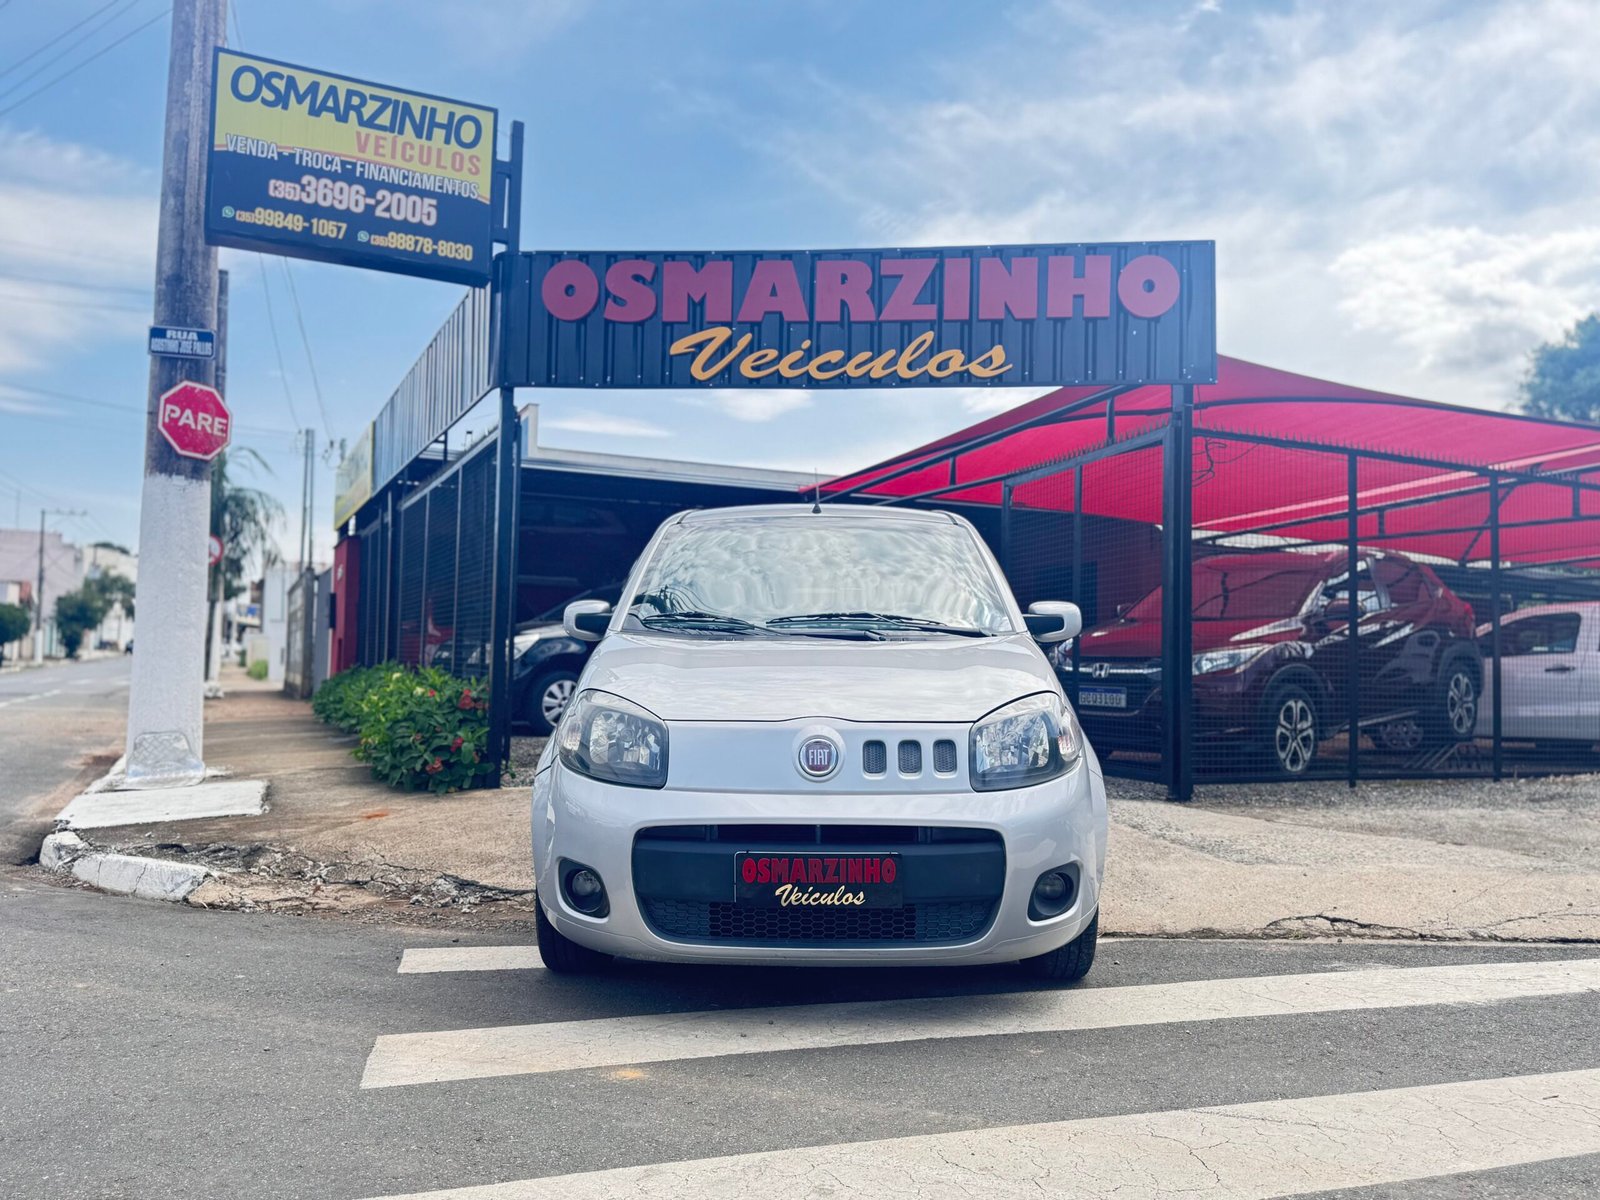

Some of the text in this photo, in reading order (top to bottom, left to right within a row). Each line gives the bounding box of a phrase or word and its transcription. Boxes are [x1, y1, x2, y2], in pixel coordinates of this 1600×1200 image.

[230, 65, 482, 149] OSMARZINHO
[226, 133, 279, 161] VENDA
[294, 147, 341, 173] TROCA
[356, 160, 479, 199] FINANCIAMENTOS
[355, 130, 481, 176] VEÍCULOS
[541, 254, 1181, 323] OSMARZINHO
[166, 329, 198, 340] RUA
[164, 404, 227, 437] PARE
[808, 748, 830, 766] FIAT
[742, 858, 896, 883] OSMARZINHO
